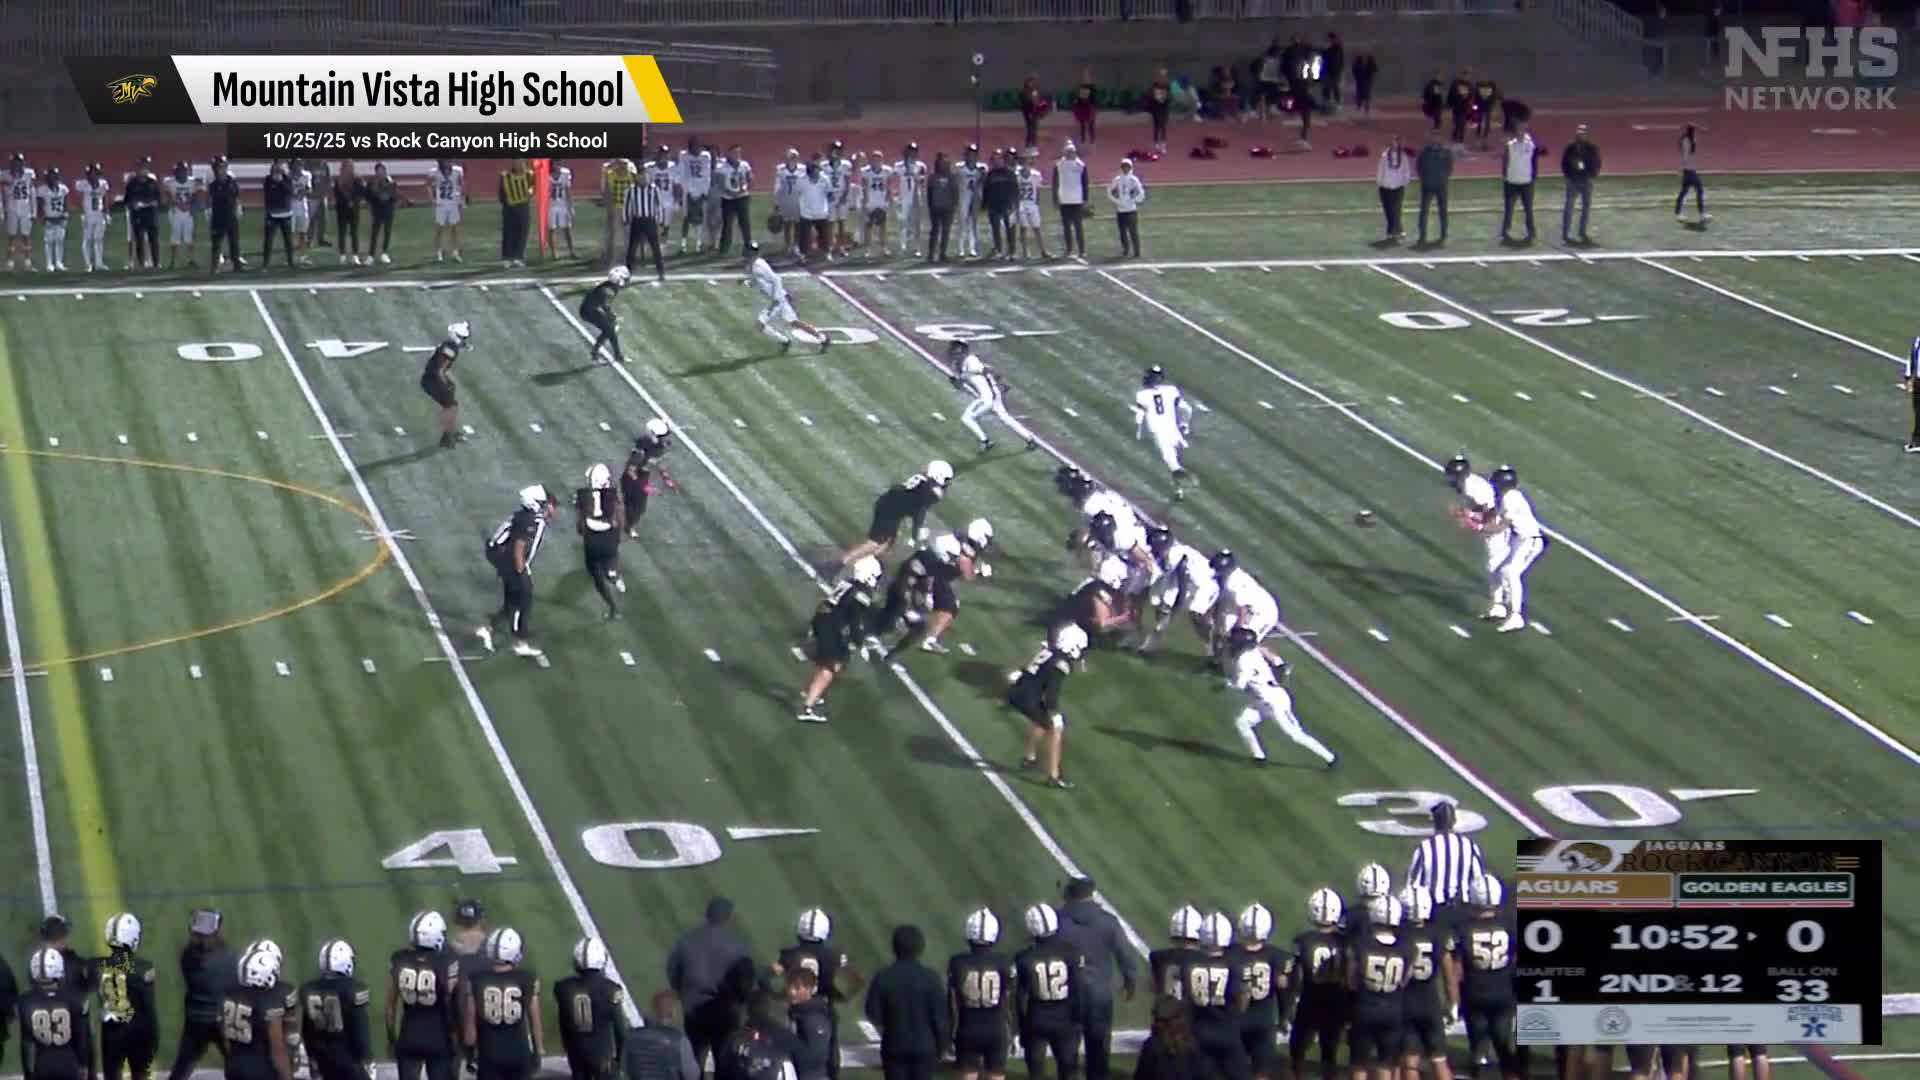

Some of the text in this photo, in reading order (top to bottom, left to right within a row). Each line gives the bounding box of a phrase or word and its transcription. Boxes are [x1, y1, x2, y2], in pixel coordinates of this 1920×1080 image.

[1153, 394, 1165, 415] 8
[591, 490, 604, 528] 1
[1645, 840, 1726, 852] JAGUARS
[1682, 881, 1848, 894] GOLDEN EAGLES
[1471, 930, 1509, 970] 52
[1524, 919, 1562, 953] 0
[1609, 924, 1739, 950] 10:52
[1786, 919, 1825, 953] 0
[1034, 959, 1069, 1001] 12
[1190, 966, 1229, 1007] 87
[1364, 955, 1404, 993] 50
[1698, 973, 1743, 993] 12
[1767, 966, 1838, 977] BALL ON
[962, 969, 1001, 1009] 40
[1532, 979, 1561, 1003] 1
[1775, 978, 1830, 1003] 33
[31, 1007, 72, 1047] 83
